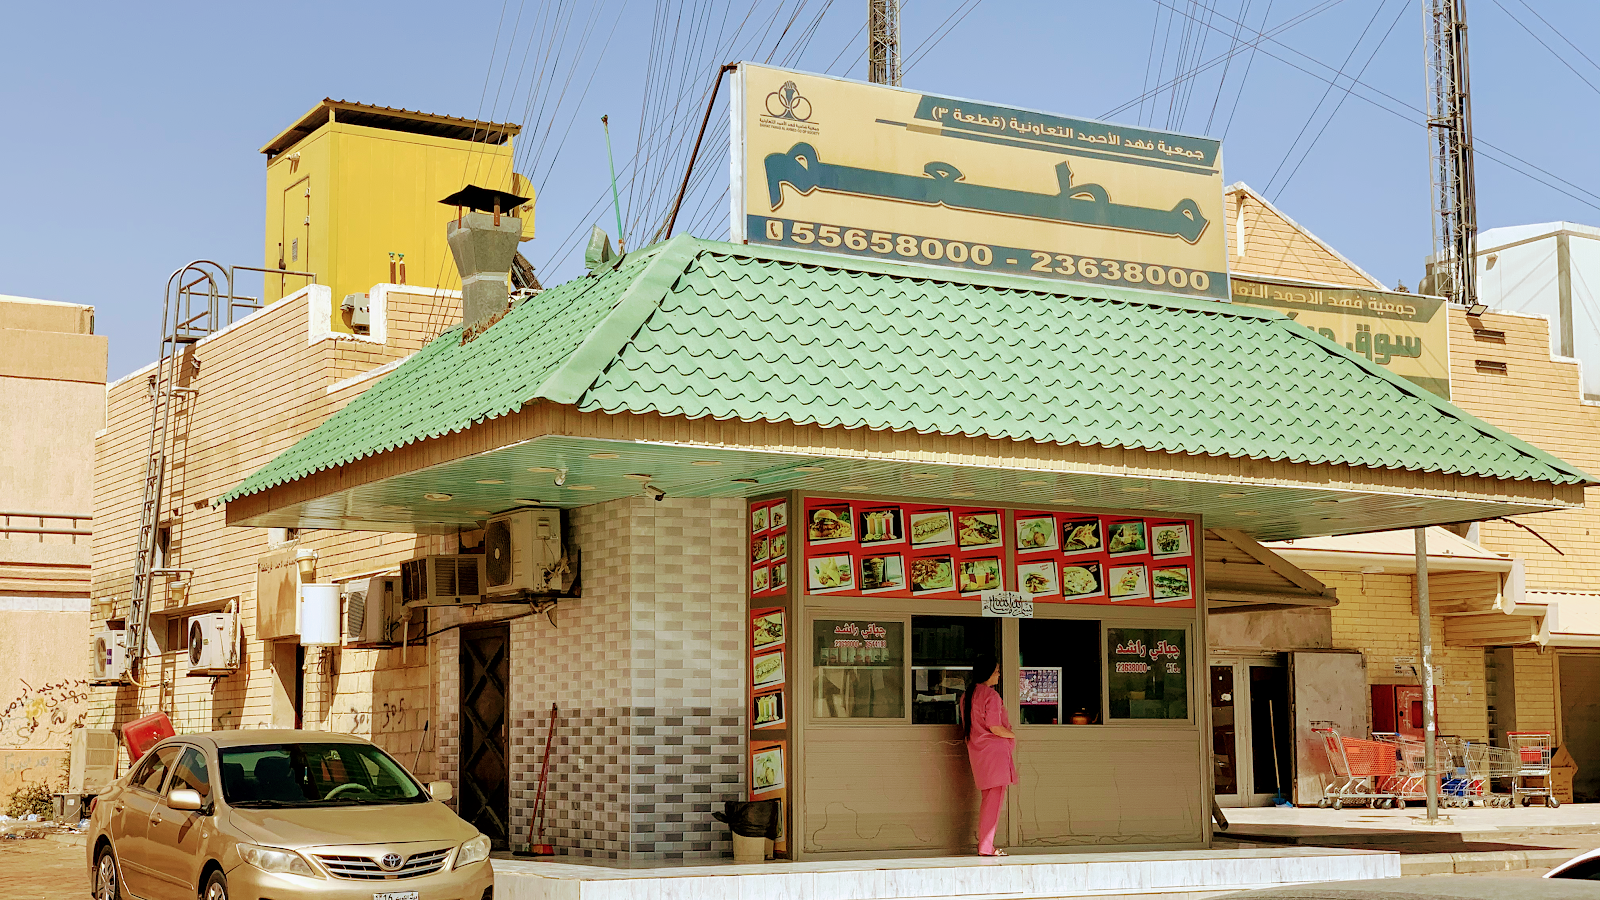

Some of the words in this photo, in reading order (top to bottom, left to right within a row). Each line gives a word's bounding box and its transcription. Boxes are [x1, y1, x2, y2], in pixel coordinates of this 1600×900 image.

[1009, 117, 1074, 139] التعاونية
[1077, 131, 1120, 146] الأحمد
[1124, 139, 1155, 151] فهد
[1157, 140, 1205, 161] جمعية
[763, 141, 1212, 246] مطعم
[789, 219, 994, 267] 55658000
[1029, 251, 1211, 293] 23638000
[1273, 288, 1323, 305] الأحمد
[1328, 295, 1363, 309] فهد
[1368, 296, 1417, 318] جمعية
[1355, 323, 1422, 365] سوق
[834, 622, 859, 636] راشد
[1116, 639, 1146, 657] راشد
